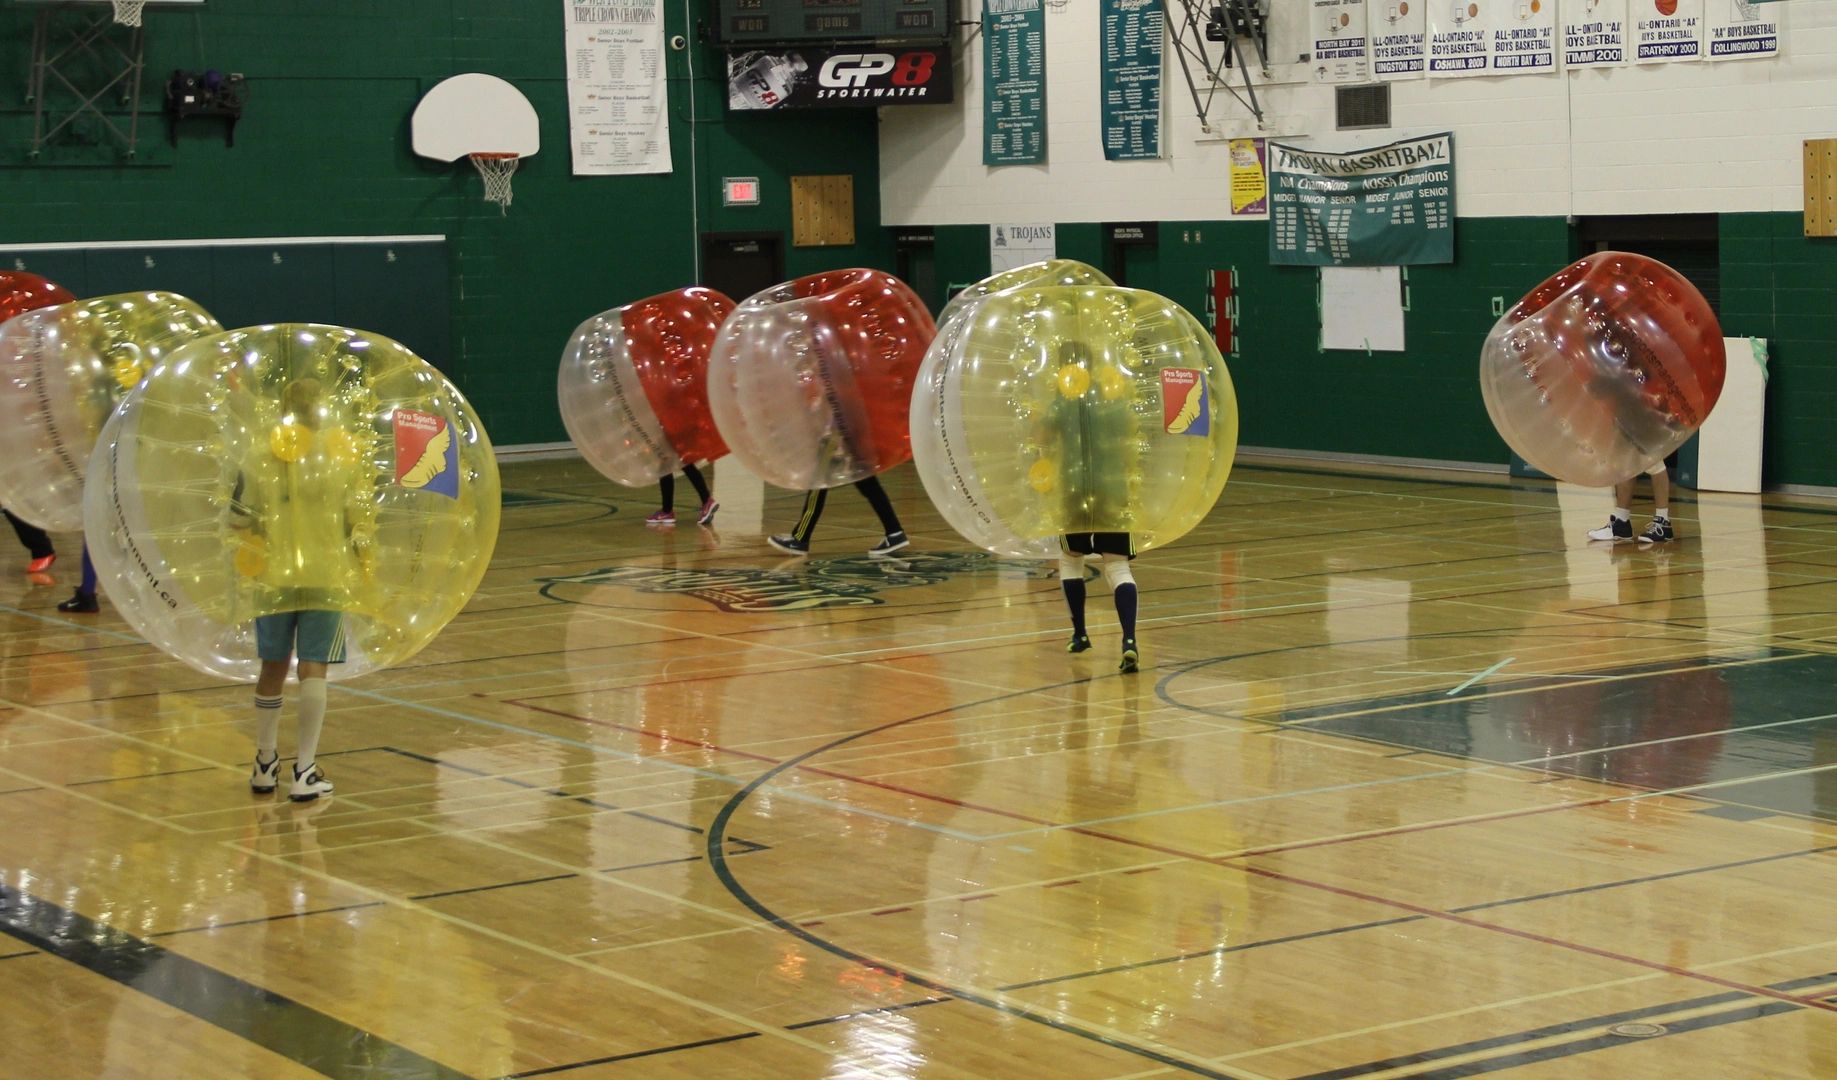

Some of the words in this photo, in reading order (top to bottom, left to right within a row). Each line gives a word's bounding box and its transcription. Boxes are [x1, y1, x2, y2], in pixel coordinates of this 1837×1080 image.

[1495, 28, 1537, 40] ALL-ONTARIO
[1657, 29, 1693, 41] BASKETBALL
[1743, 23, 1776, 36] BASKETBALL
[1373, 34, 1409, 46] LL-ONTARIO
[1495, 41, 1513, 52] BOYS
[1515, 39, 1551, 51] BASKETBALL
[1565, 36, 1585, 47] OYS
[1374, 48, 1389, 58] OYS
[1432, 45, 1450, 56] BOYS
[1450, 42, 1487, 55] BASKETBALL
[1680, 43, 1697, 54] 2000
[1714, 41, 1760, 53] COLLINGWOOD
[1595, 49, 1622, 61] 2001
[1435, 59, 1466, 70] OSHAWA
[1496, 56, 1520, 68] NORTH
[1521, 55, 1533, 67] BAY
[818, 52, 936, 87] GP8
[817, 87, 928, 98] SPORTWATER
[1279, 149, 1337, 174] TROJAN
[1338, 141, 1446, 174] BASKETBALL
[1398, 170, 1448, 187] Champions
[1365, 192, 1390, 203] MIDGET
[1419, 186, 1448, 198] SENIOR
[1010, 226, 1052, 243] TROJANS
[397, 411, 412, 420] Pro
[412, 413, 437, 426] Sports
